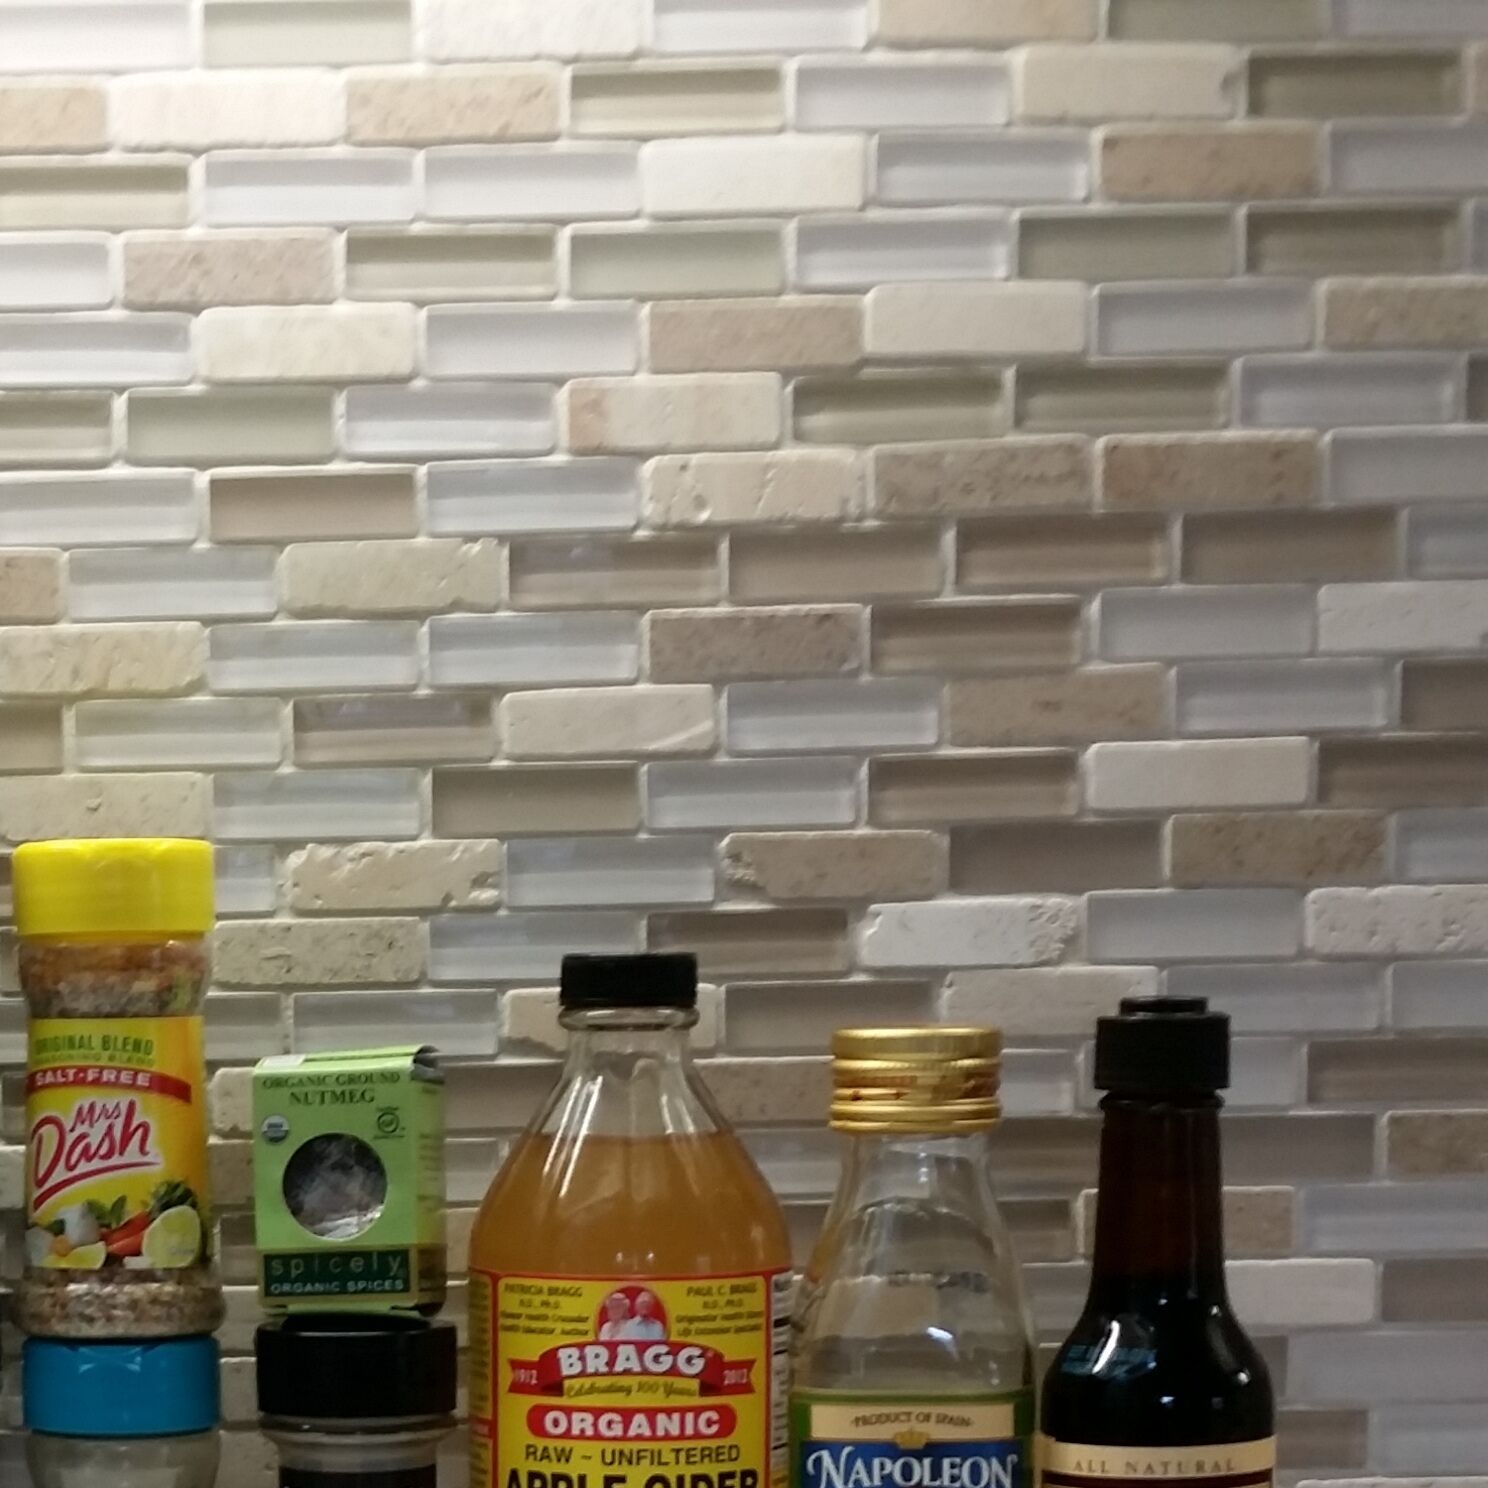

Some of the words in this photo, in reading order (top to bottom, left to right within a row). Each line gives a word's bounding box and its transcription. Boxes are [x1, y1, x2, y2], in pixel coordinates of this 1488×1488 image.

[101, 1035, 154, 1056] BLEND
[263, 1074, 332, 1089] ORGANIC
[335, 1072, 400, 1085] GROUND
[289, 1089, 375, 1106] NUTMEG
[31, 1099, 151, 1189] Dash
[270, 1252, 402, 1278] spicely
[270, 1281, 340, 1293] ORGANIC
[346, 1279, 404, 1292] SPICES
[557, 1344, 706, 1376] BRAGG
[544, 1410, 720, 1438] ORGANIC
[525, 1443, 573, 1464] RAW
[601, 1443, 741, 1467] UNFILTERED
[1073, 1459, 1109, 1474] ALL
[1126, 1458, 1235, 1474] NATURAL
